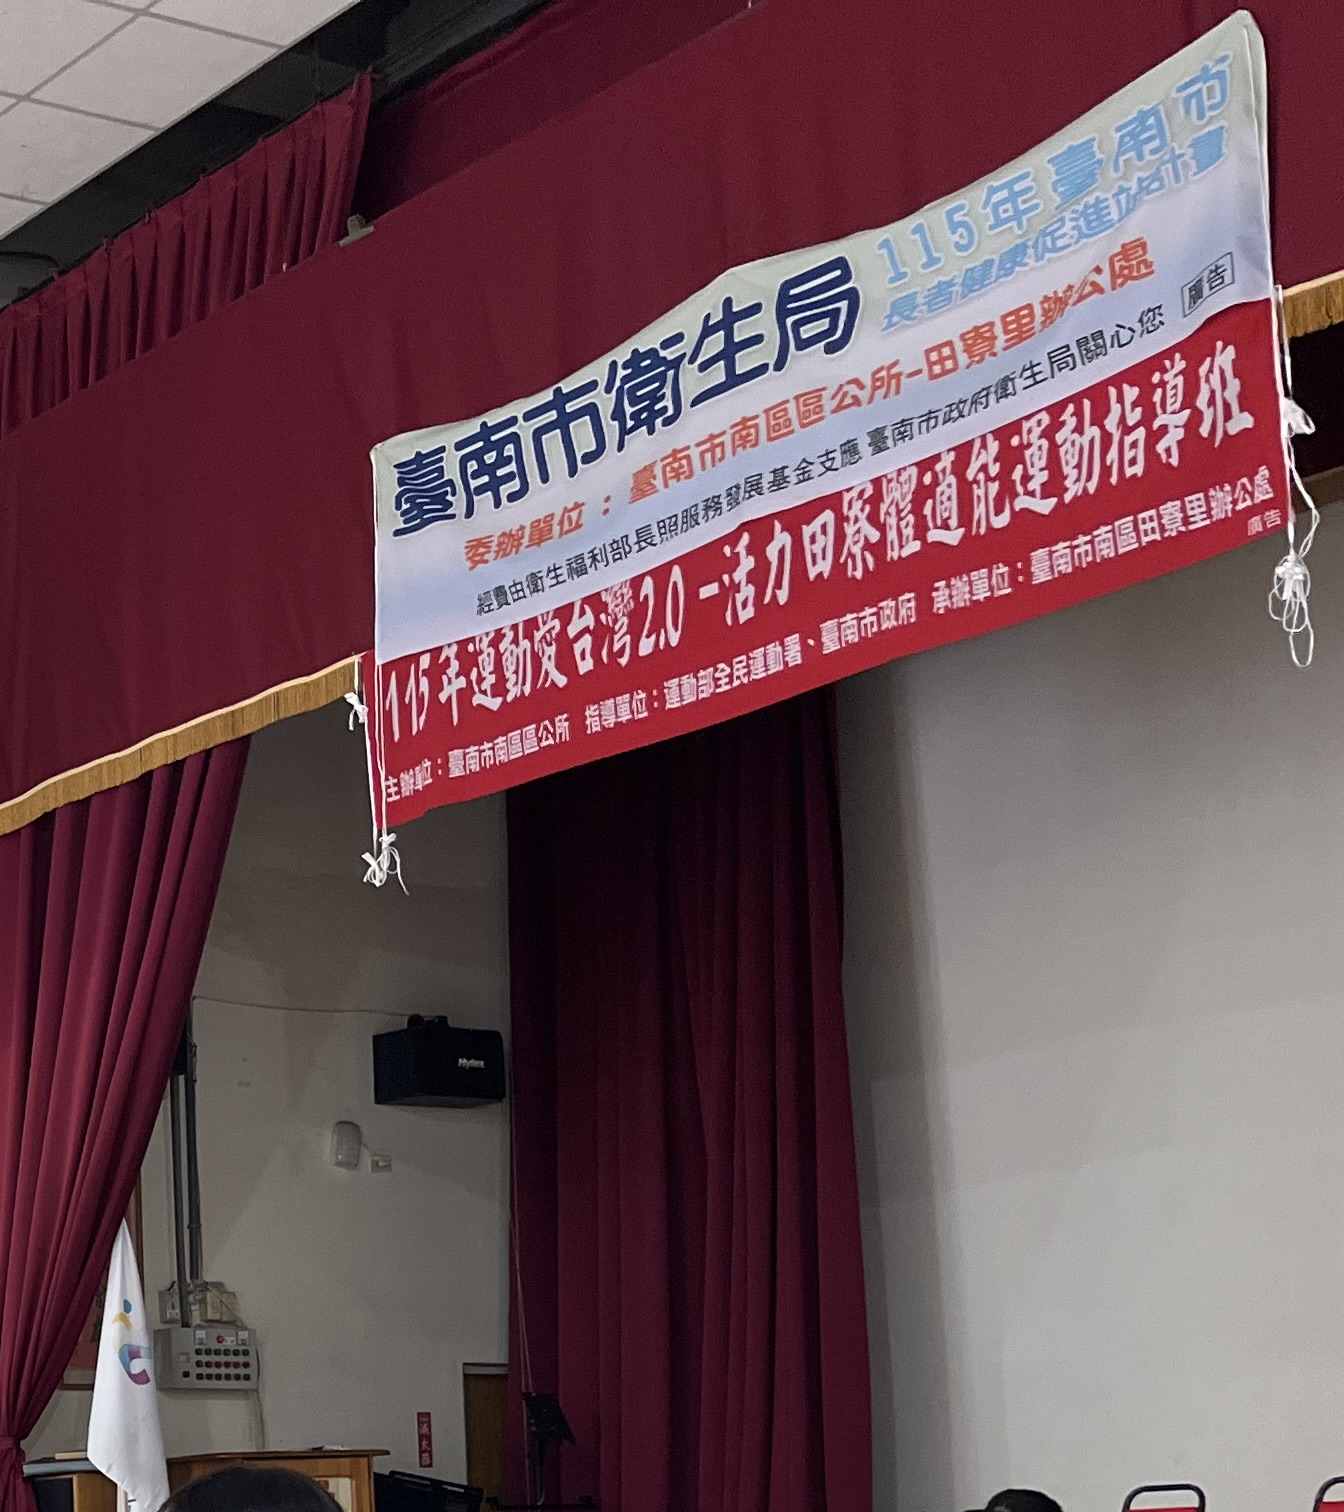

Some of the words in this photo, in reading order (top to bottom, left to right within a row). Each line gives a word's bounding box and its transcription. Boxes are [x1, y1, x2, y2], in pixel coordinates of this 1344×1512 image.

[878, 52, 1233, 284] 115年臺南市
[392, 256, 861, 538] 臺南市衛生局
[866, 302, 1165, 457] 臺南市政府衛生局關心您
